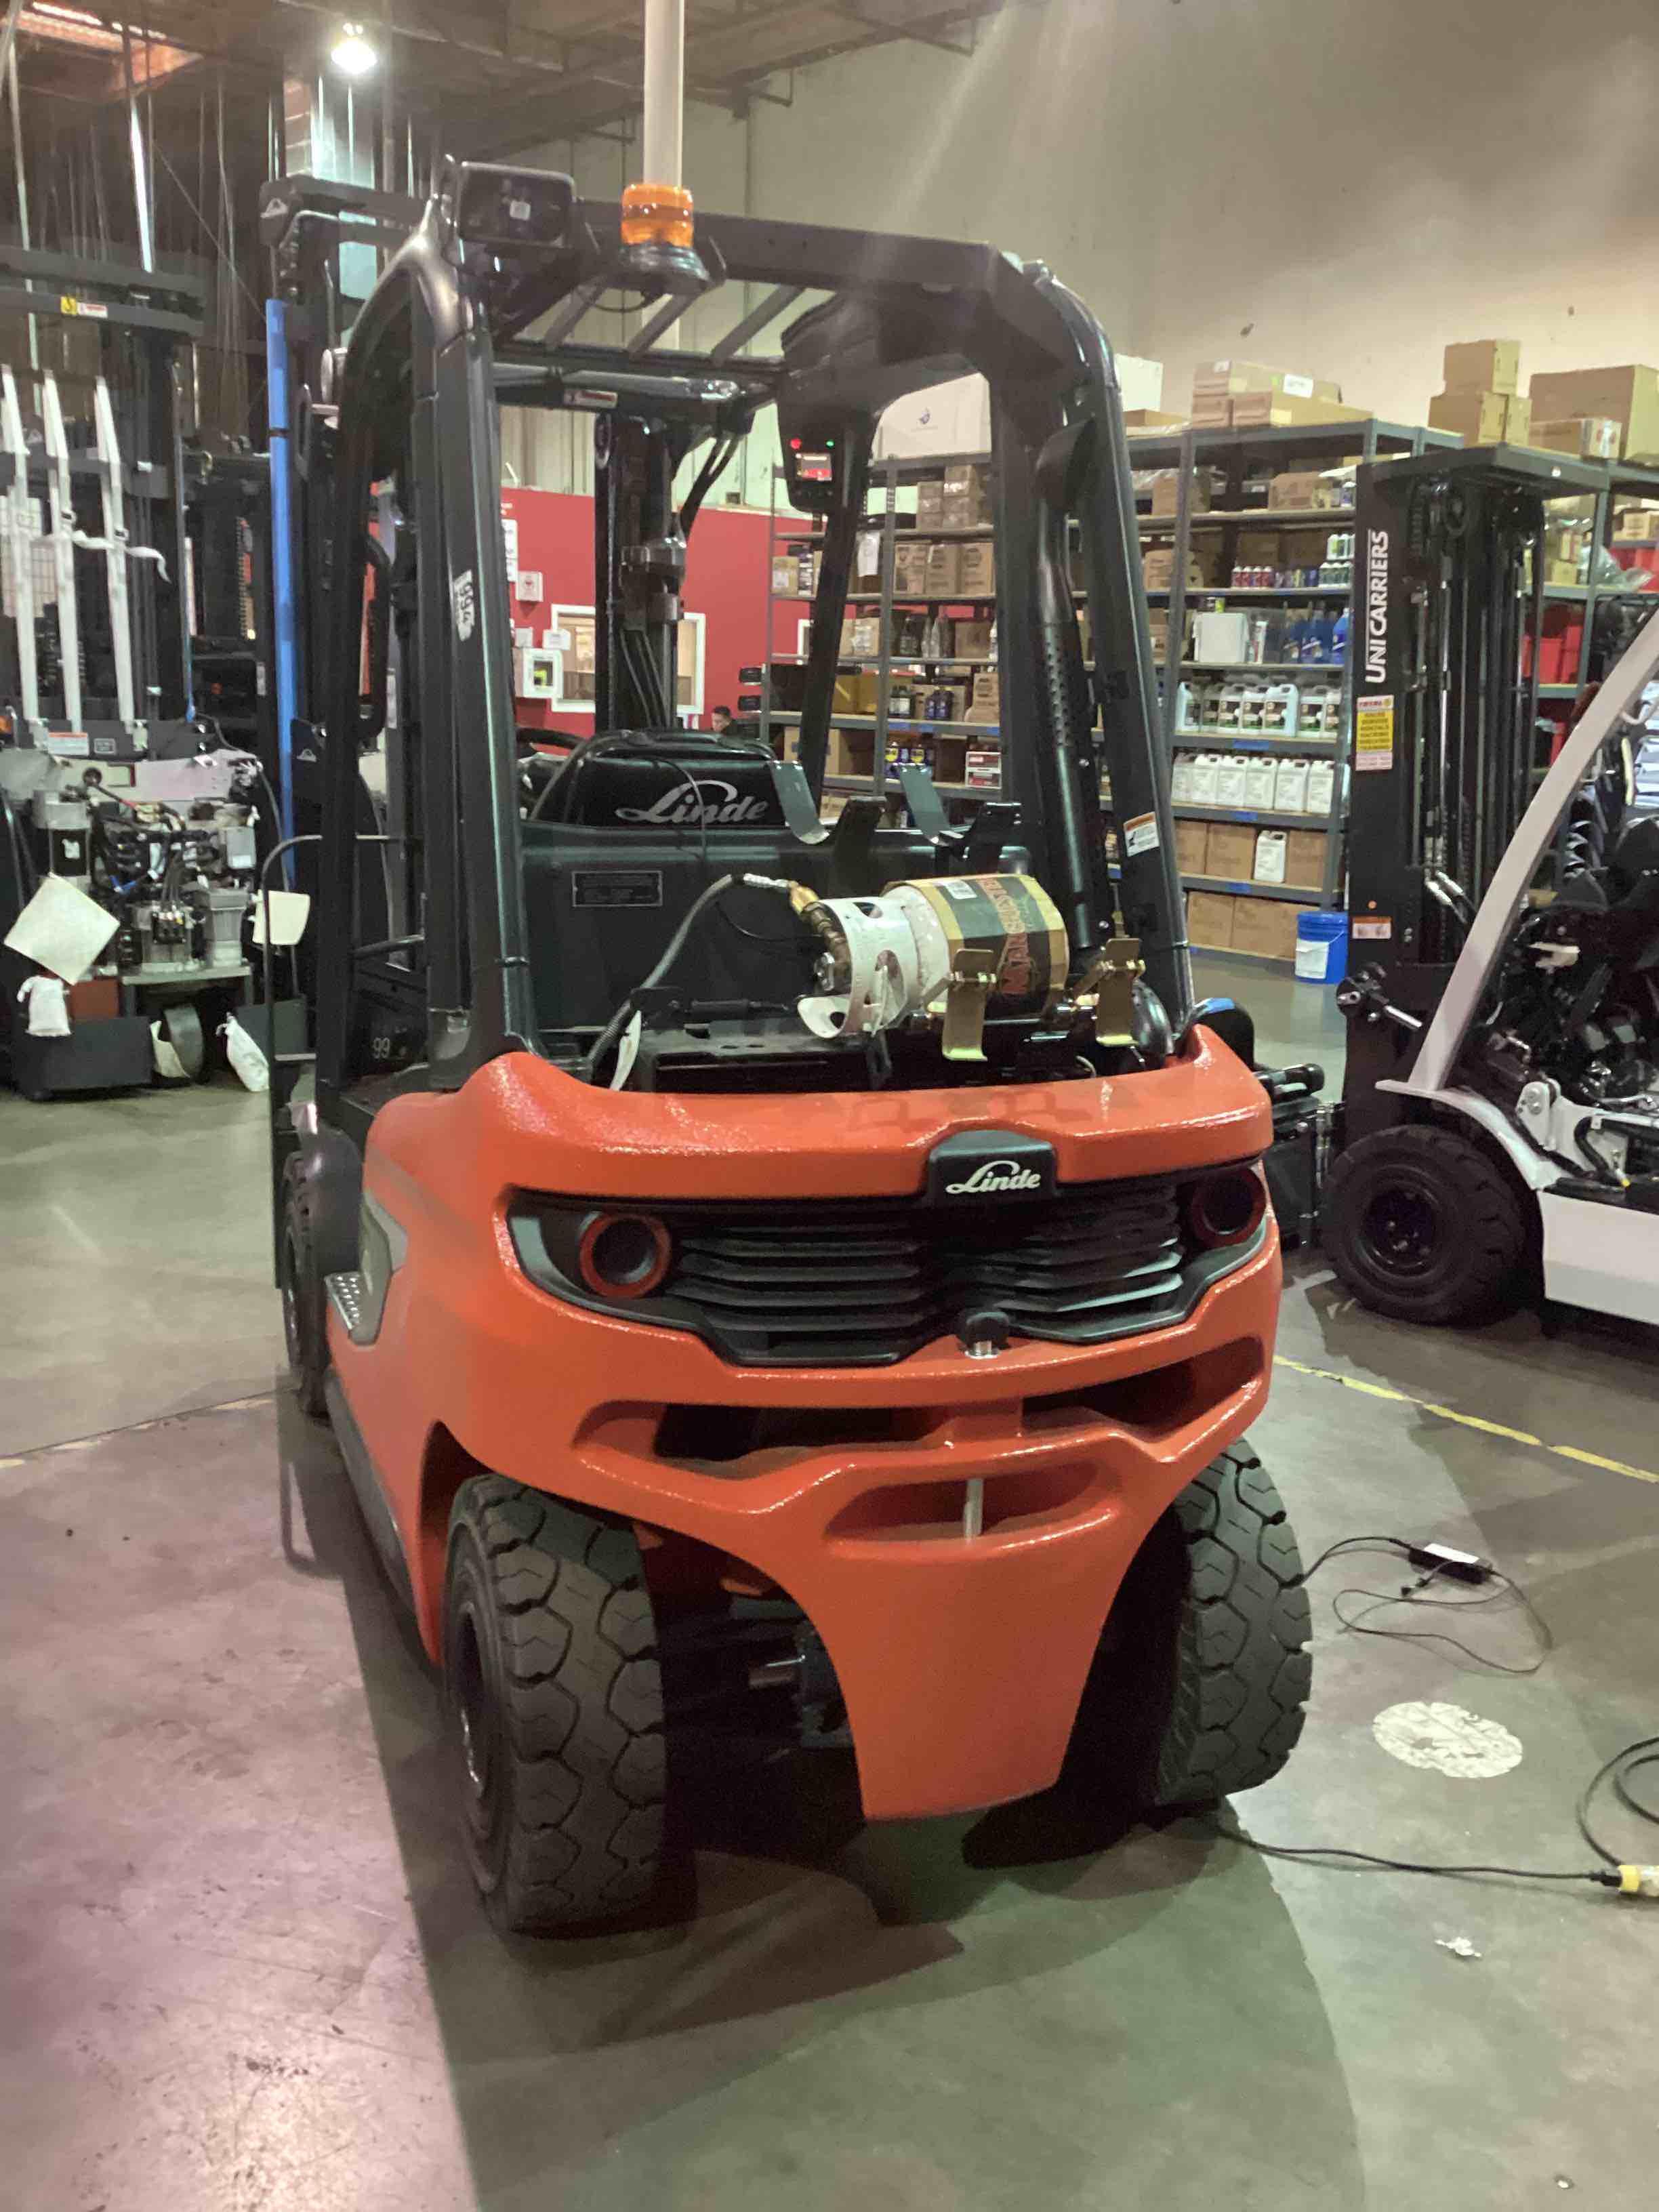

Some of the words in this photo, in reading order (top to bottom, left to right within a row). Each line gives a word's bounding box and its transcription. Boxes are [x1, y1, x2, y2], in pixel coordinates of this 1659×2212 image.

[1365, 530, 1389, 683] UNICARRIERS
[614, 780, 769, 823] Linde
[945, 1160, 1042, 1194] Linde
